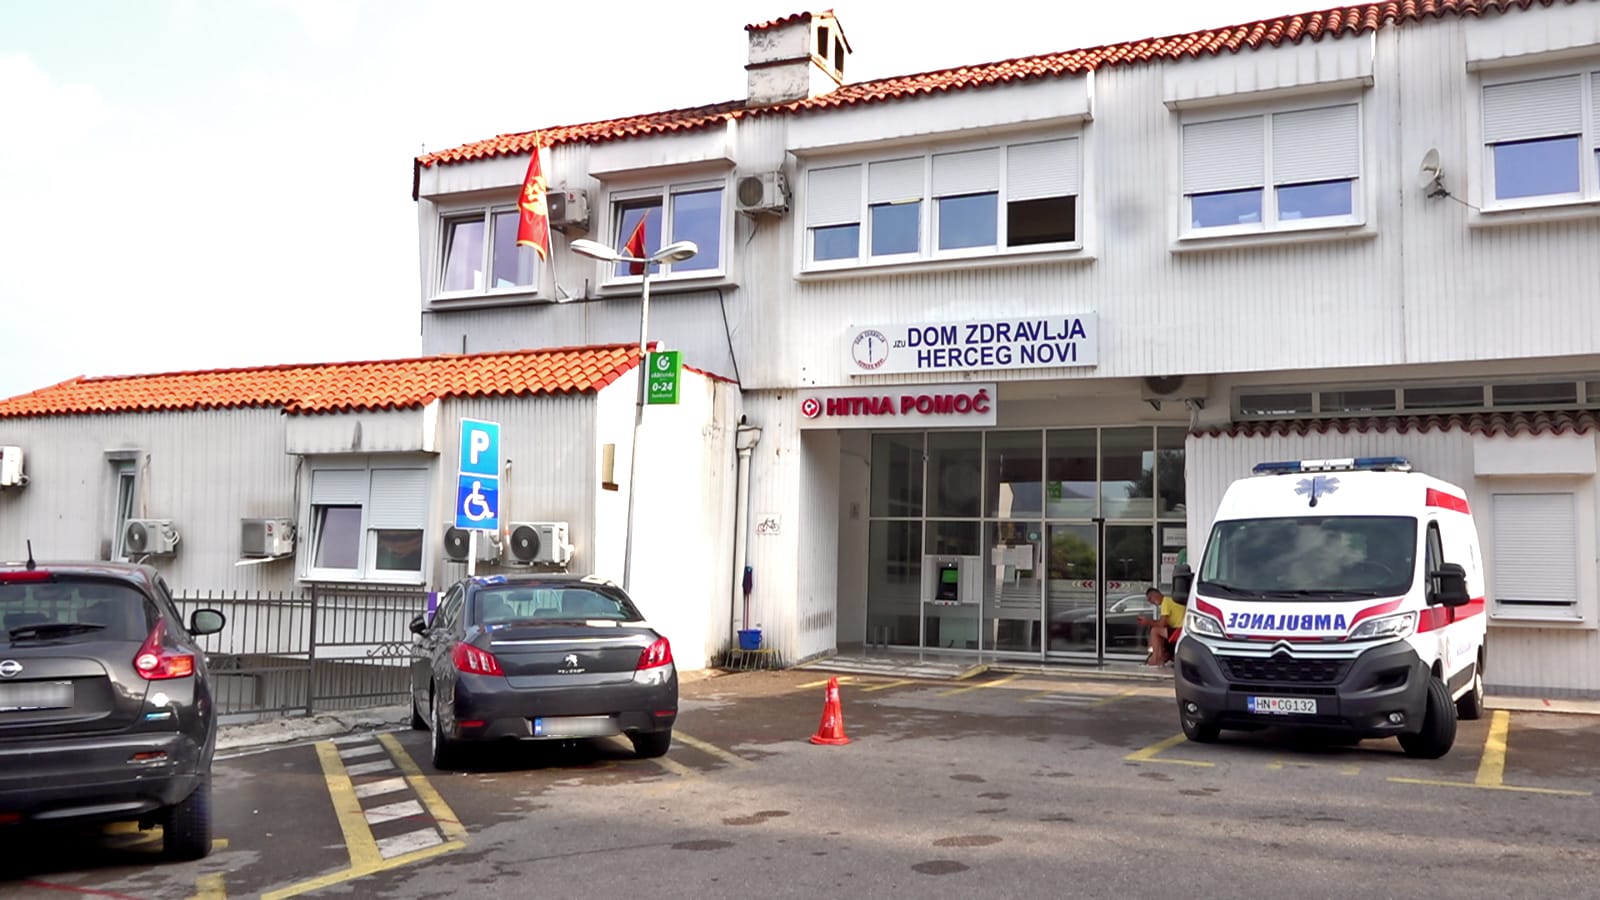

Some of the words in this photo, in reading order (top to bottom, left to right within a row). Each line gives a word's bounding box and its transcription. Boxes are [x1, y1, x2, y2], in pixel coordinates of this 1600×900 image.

[907, 325, 958, 347] DOM
[965, 318, 1087, 344] ZDRAVLJA
[917, 347, 1012, 368] HERCEG
[1020, 342, 1077, 364] NOVI
[652, 382, 673, 391] 0-24
[826, 396, 896, 418] HITNA
[470, 429, 490, 464] P
[1256, 699, 1271, 709] HN
[1278, 700, 1314, 712] CG132
